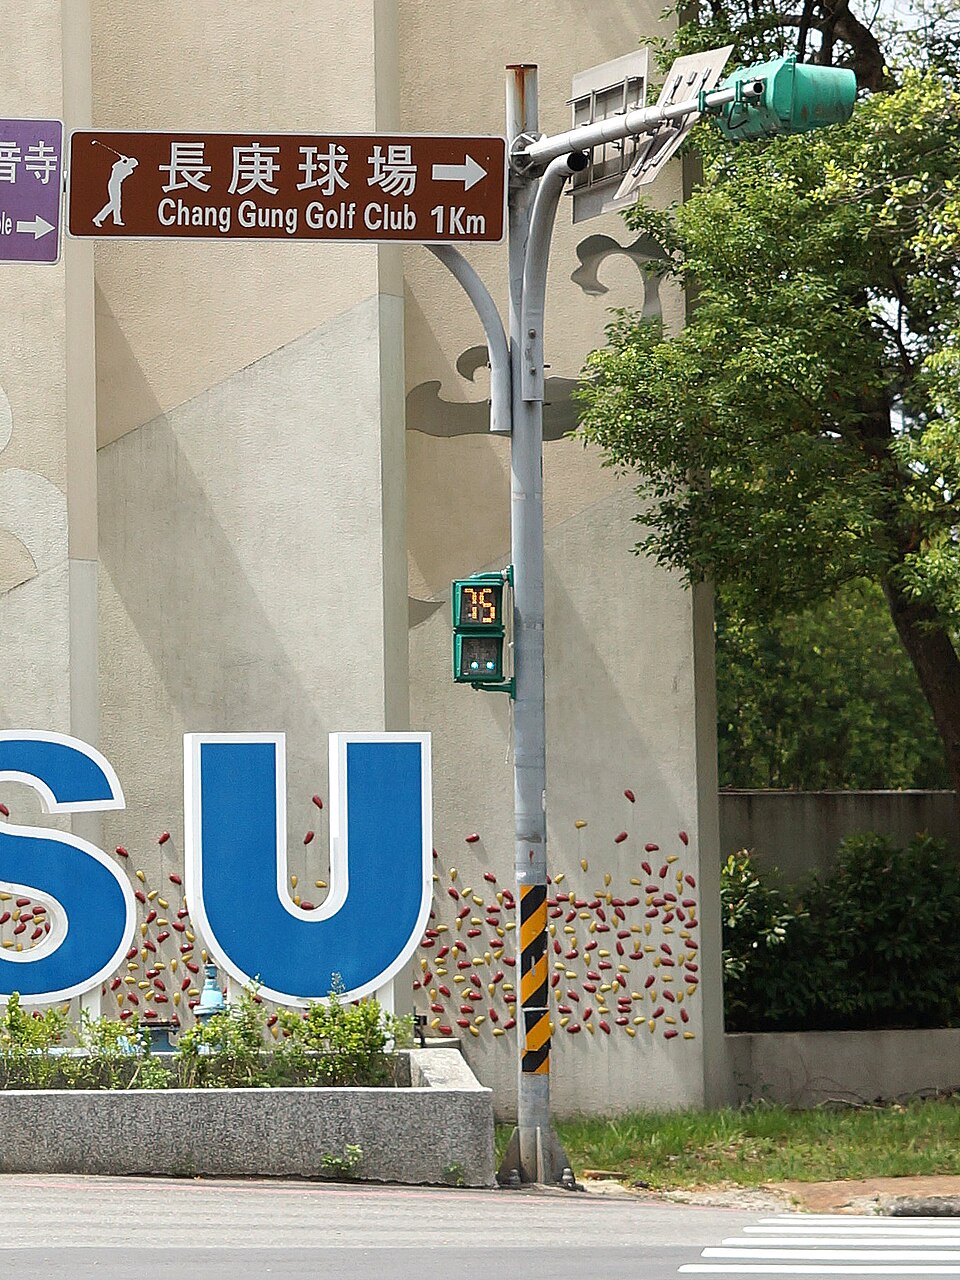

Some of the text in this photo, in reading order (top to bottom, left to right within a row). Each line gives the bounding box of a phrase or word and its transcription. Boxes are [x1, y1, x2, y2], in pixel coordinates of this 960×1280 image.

[158, 142, 418, 197] 長庚球場
[158, 198, 486, 235] Chang Gung Golf Club 1Km
[464, 588, 496, 623] 75
